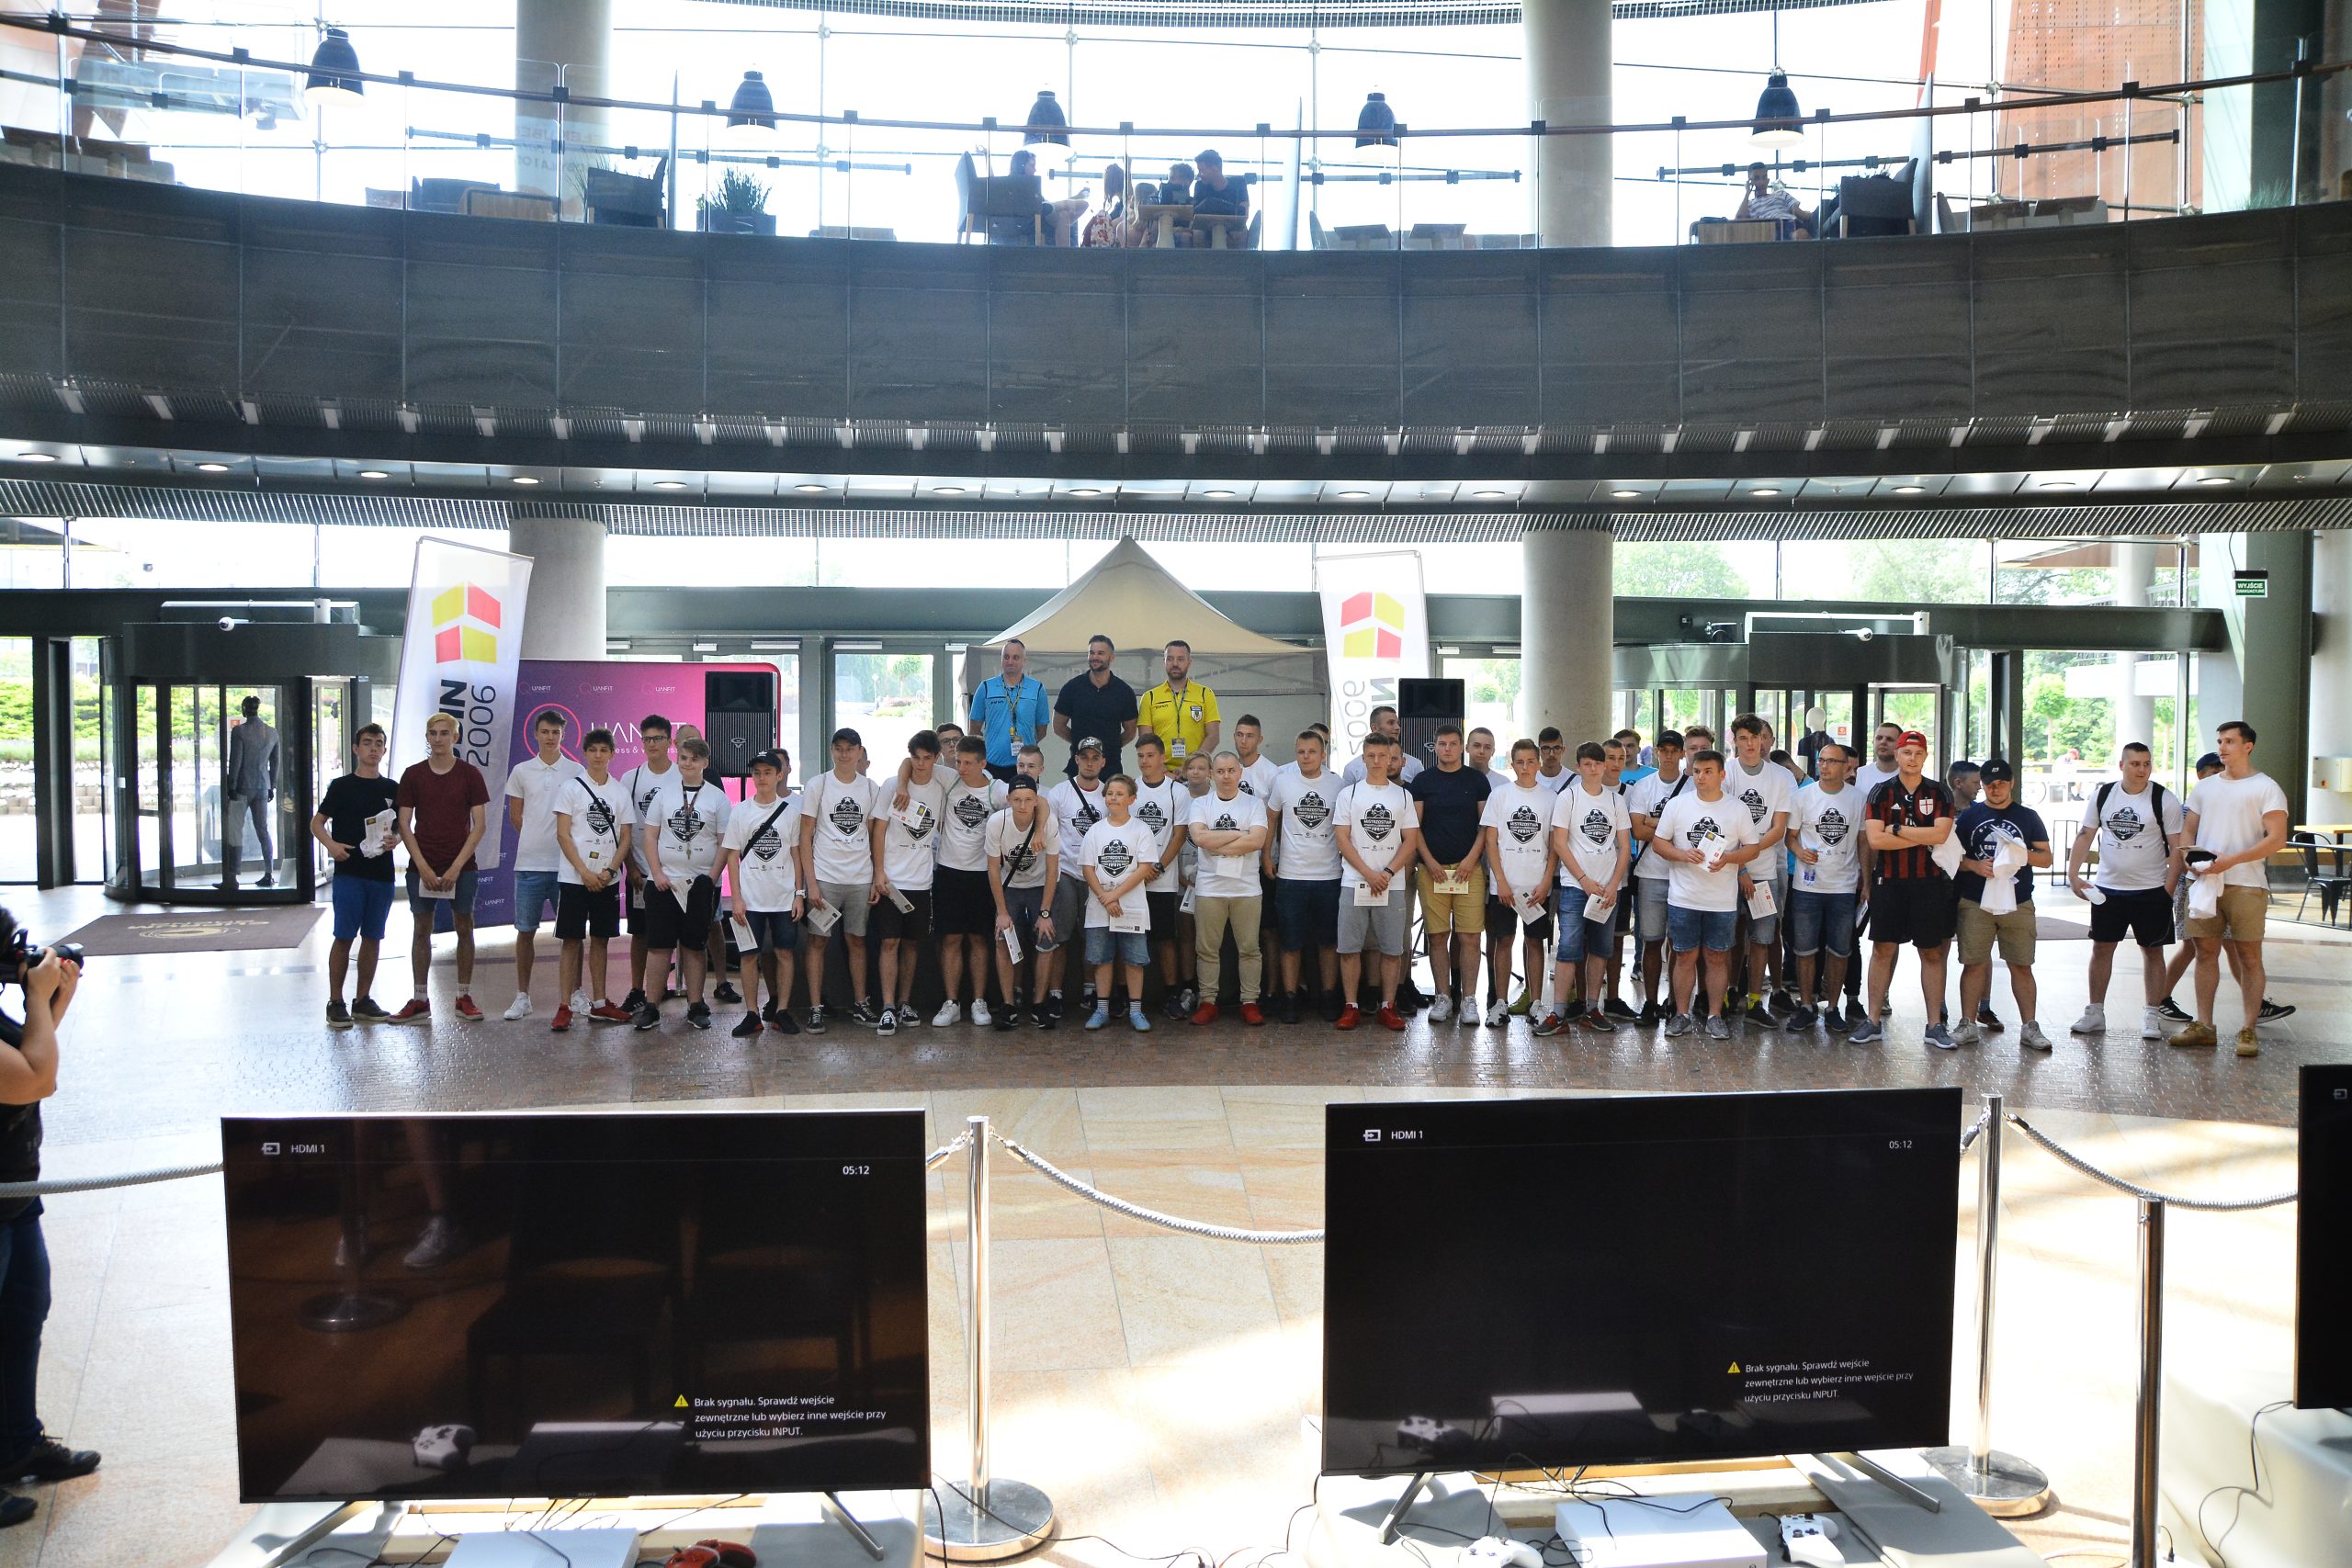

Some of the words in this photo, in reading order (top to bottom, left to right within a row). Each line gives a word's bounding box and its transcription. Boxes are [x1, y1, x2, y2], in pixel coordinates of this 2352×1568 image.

[466, 684, 496, 768] 2006
[1391, 1130, 1416, 1139] HDMI
[1419, 1130, 1423, 1139] 1
[291, 1145, 318, 1153] HDMI
[321, 1145, 324, 1153] 1
[1889, 1140, 1912, 1149] 05:12
[842, 1166, 870, 1175] 05:12
[1767, 1363, 1800, 1373] sygnału.
[1803, 1360, 1837, 1371] Sprawdź
[1839, 1359, 1869, 1370] wejście
[1746, 1379, 1793, 1388] zewnętrzne
[1811, 1376, 1842, 1386] wybierz
[1864, 1373, 1894, 1382] wejście
[1896, 1373, 1913, 1382] przy
[695, 1398, 715, 1406] Brak
[718, 1398, 755, 1408] sygnału.
[758, 1395, 797, 1407] Sprawdź
[800, 1395, 834, 1406] wejście
[1745, 1395, 1770, 1404] użyciu
[1773, 1392, 1810, 1403] przycisku
[1814, 1390, 1838, 1398] INPUT.
[695, 1414, 749, 1424] zewnętrzne
[769, 1412, 804, 1423] wybierz
[830, 1410, 864, 1421] wejście
[866, 1412, 886, 1420] przy
[696, 1429, 725, 1439] użyciu
[728, 1428, 770, 1438] przycisku
[773, 1427, 802, 1436] INPUT.
